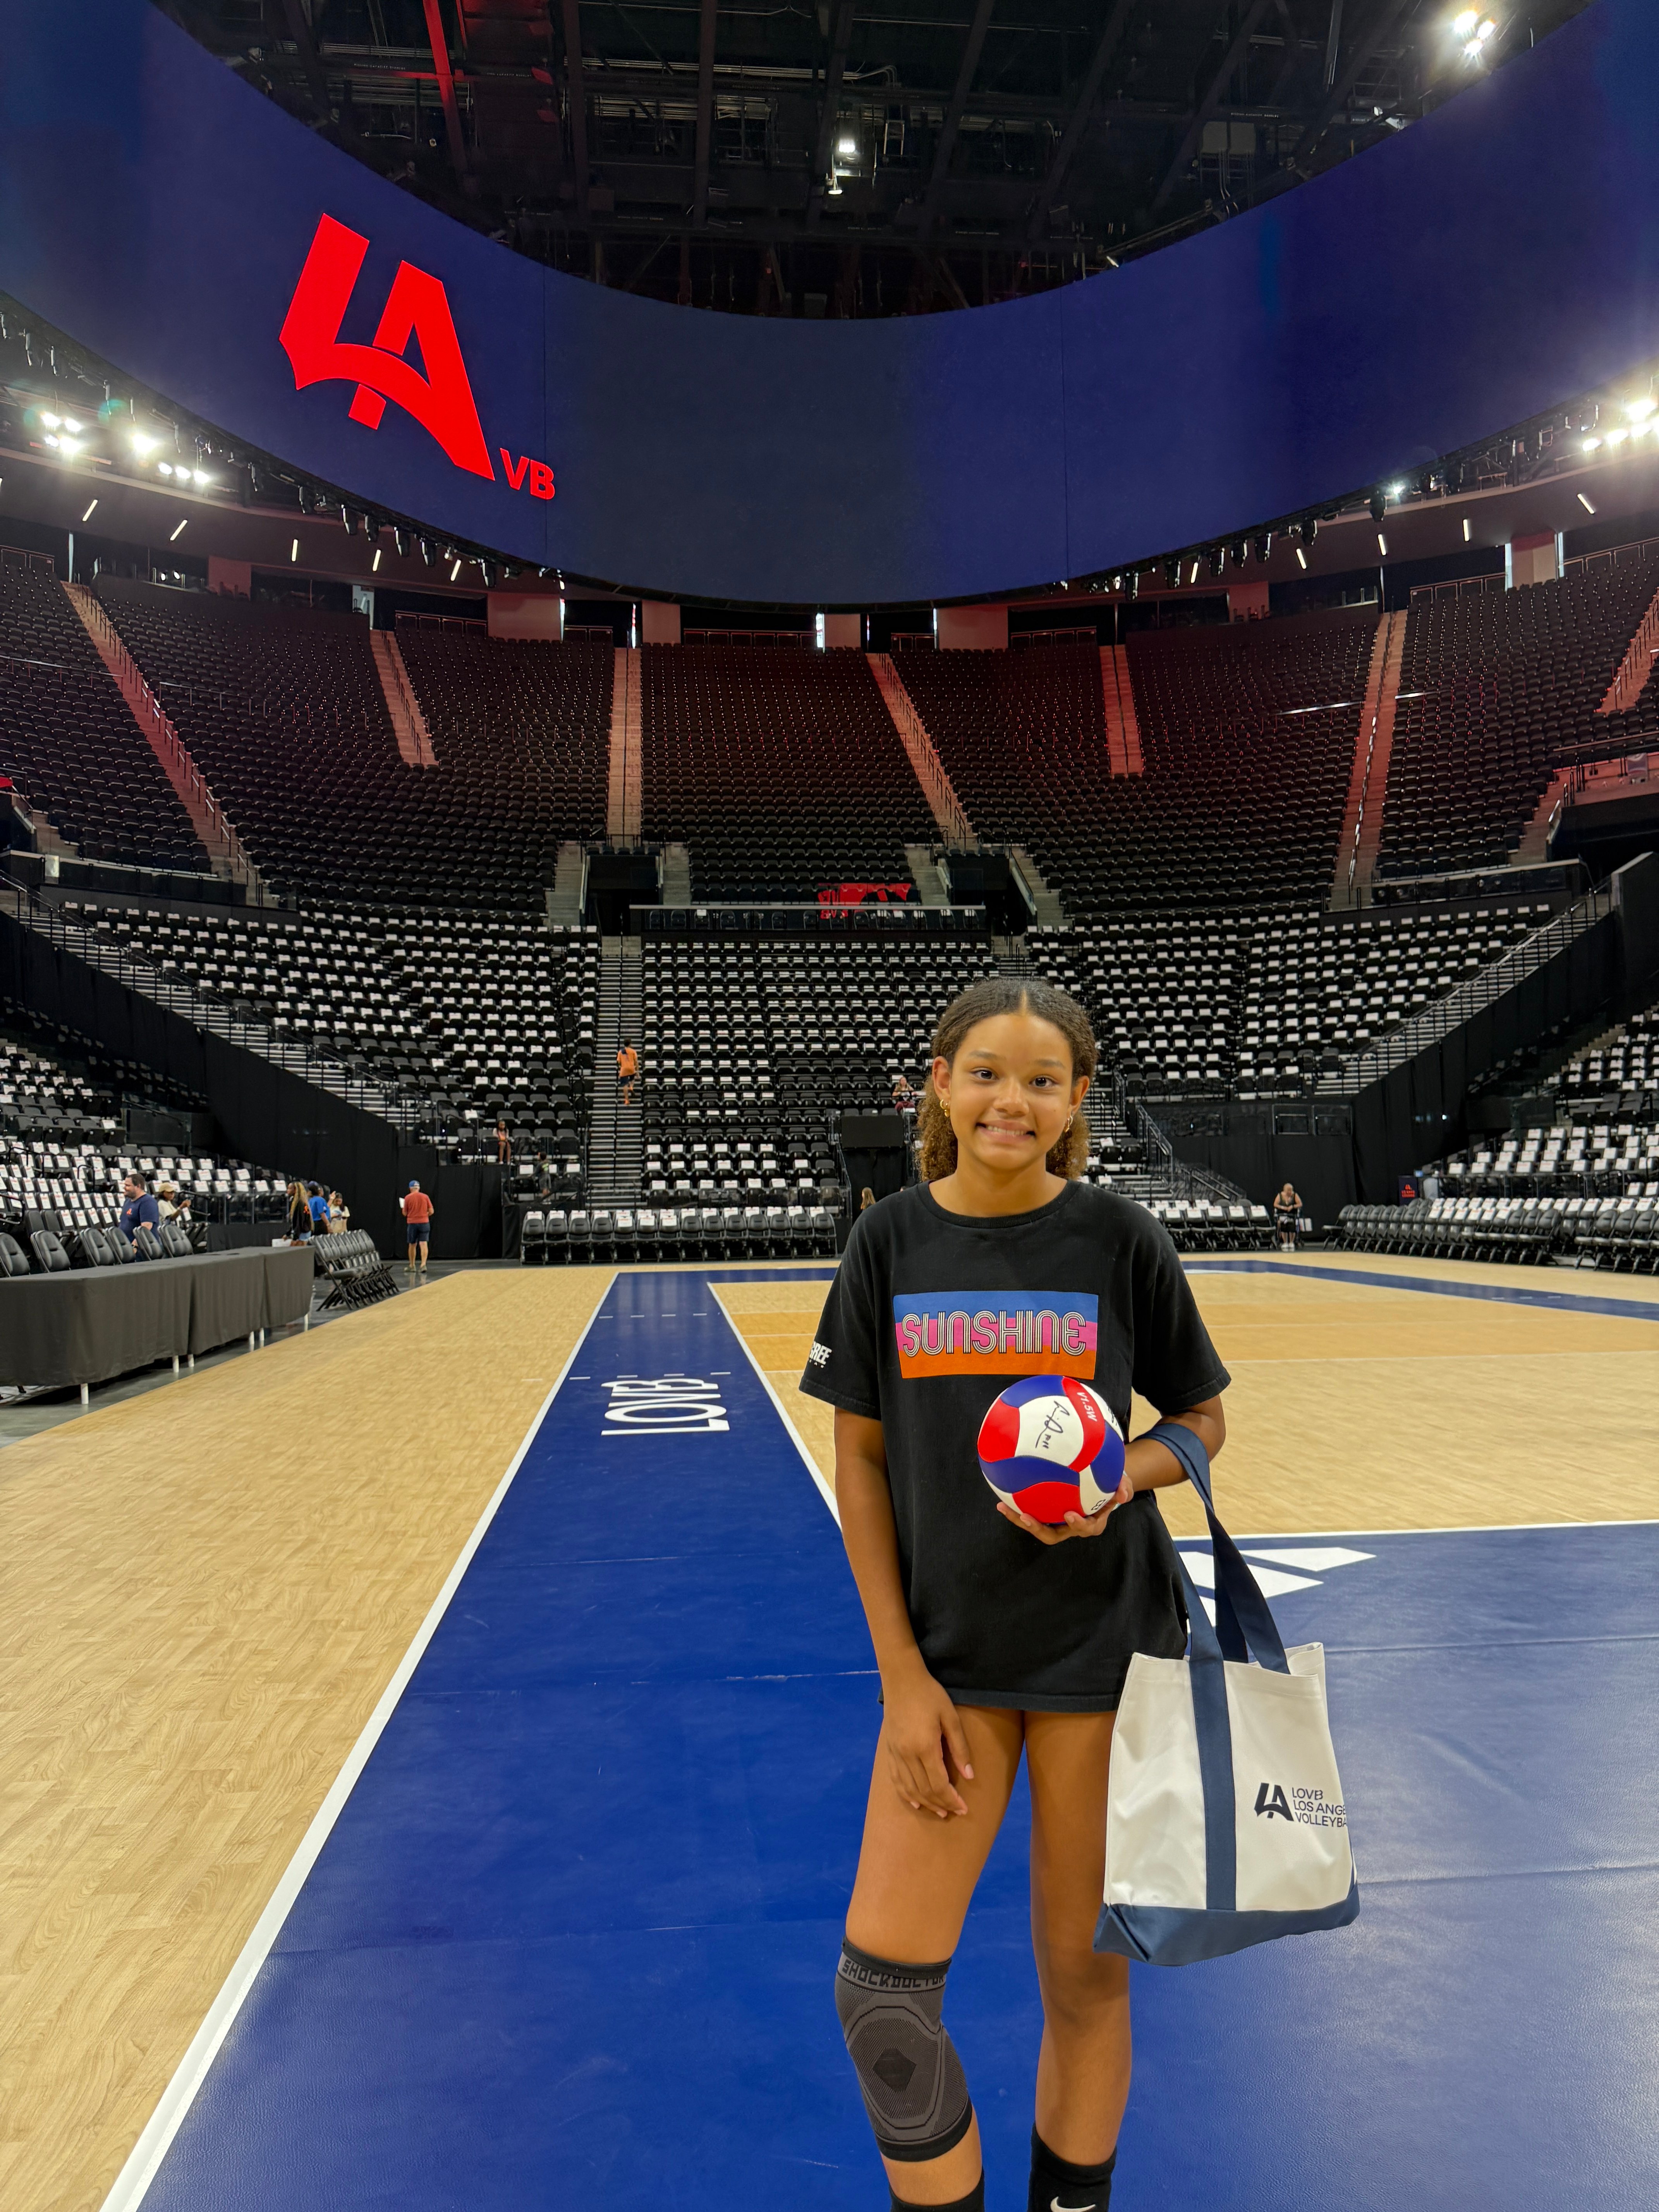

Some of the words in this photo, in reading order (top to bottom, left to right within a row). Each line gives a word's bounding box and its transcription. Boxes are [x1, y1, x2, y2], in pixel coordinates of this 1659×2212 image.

[500, 448, 555, 500] VB
[902, 1310, 1086, 1357] SUNSHINE
[601, 1378, 730, 1436] LOVB
[1077, 1392, 1097, 1422] V1.5W
[1292, 1787, 1323, 1800] LOVB
[1293, 1800, 1314, 1812] LOS
